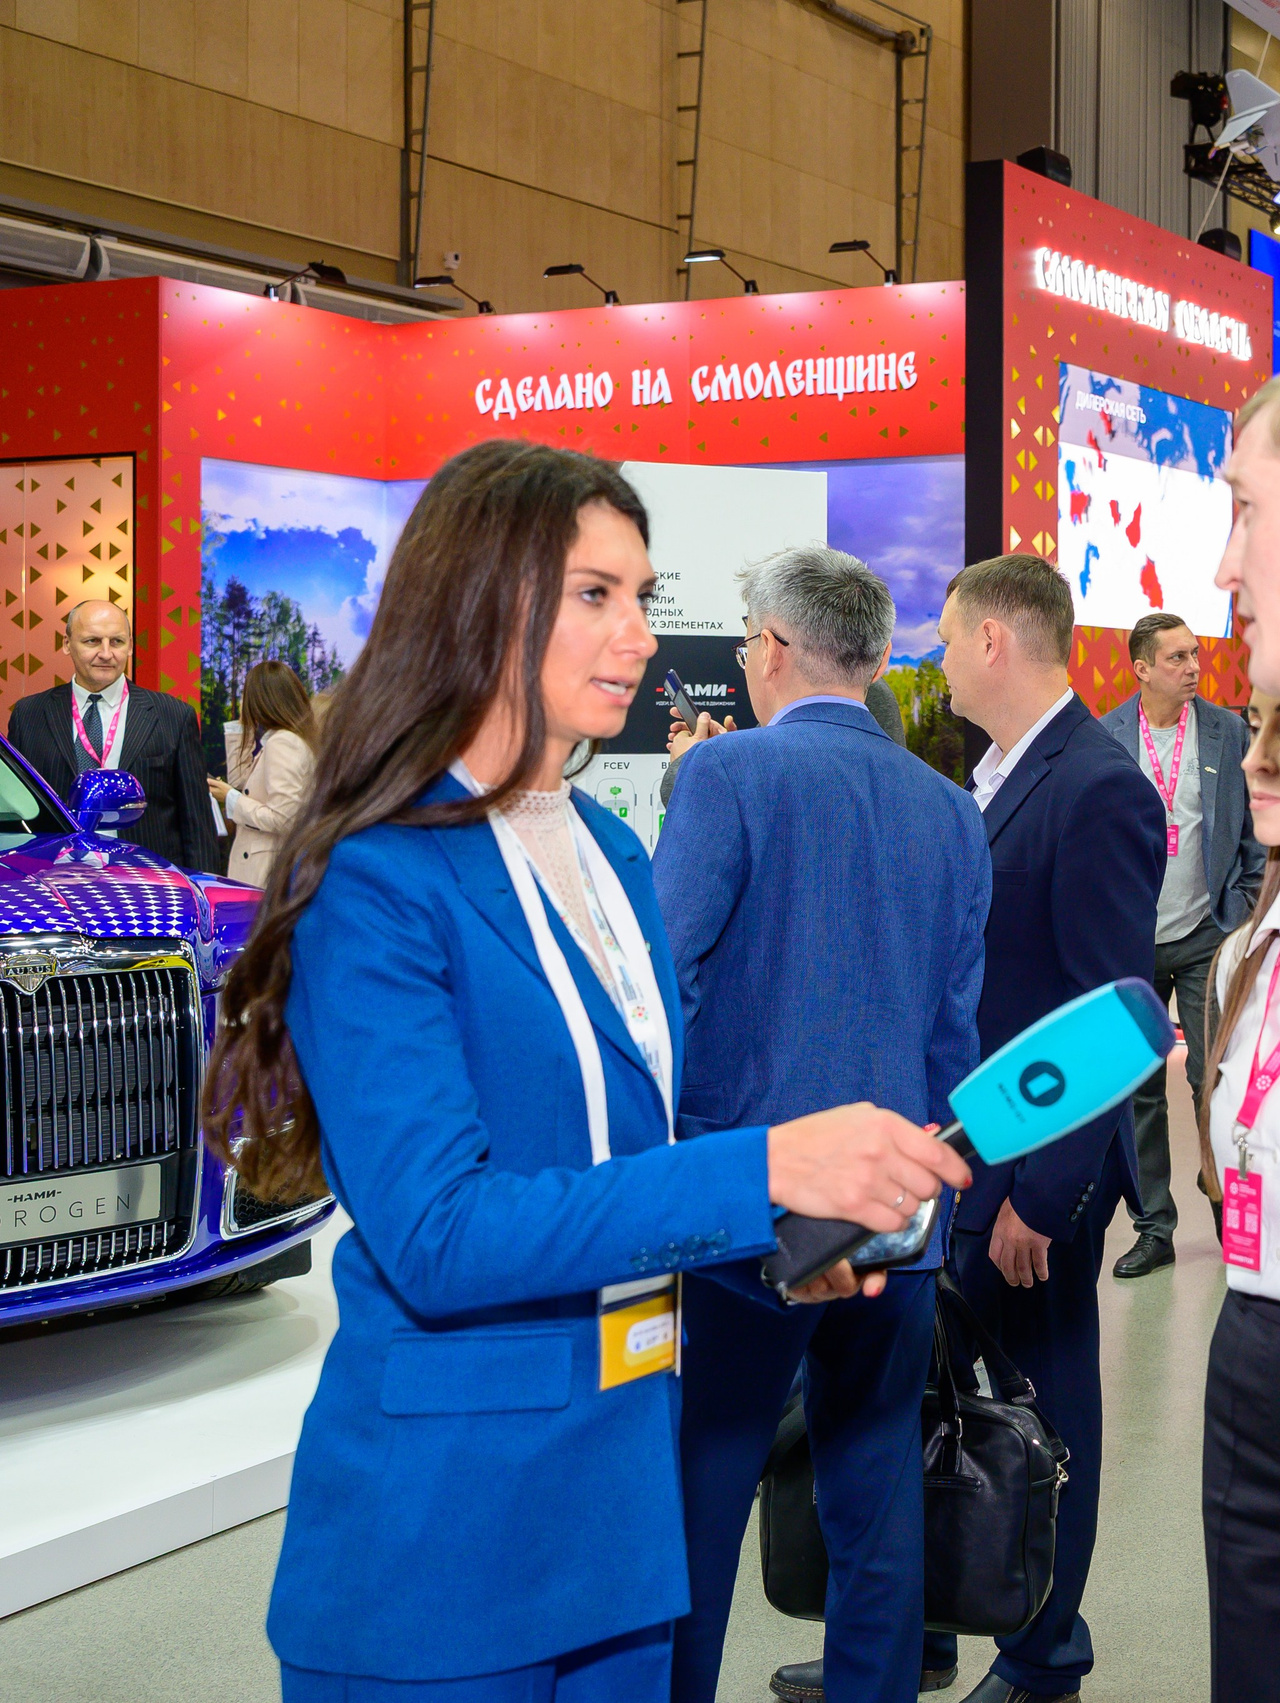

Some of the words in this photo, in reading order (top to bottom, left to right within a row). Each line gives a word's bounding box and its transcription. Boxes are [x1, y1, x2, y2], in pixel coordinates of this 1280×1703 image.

[475, 372, 613, 421] СДЕЛАНО
[631, 367, 673, 407] НА
[690, 351, 918, 402] СМОЛЕНЩИНЕ
[1076, 390, 1126, 419] ДИЛЕРСКАЯ
[1126, 405, 1147, 424] СЕТЬ
[659, 620, 724, 630] ЭЛЕМЕНТАХ
[603, 761, 631, 770] FCEV
[8, 965, 52, 976] AURUS
[0, 1193, 130, 1228] ROGEN
